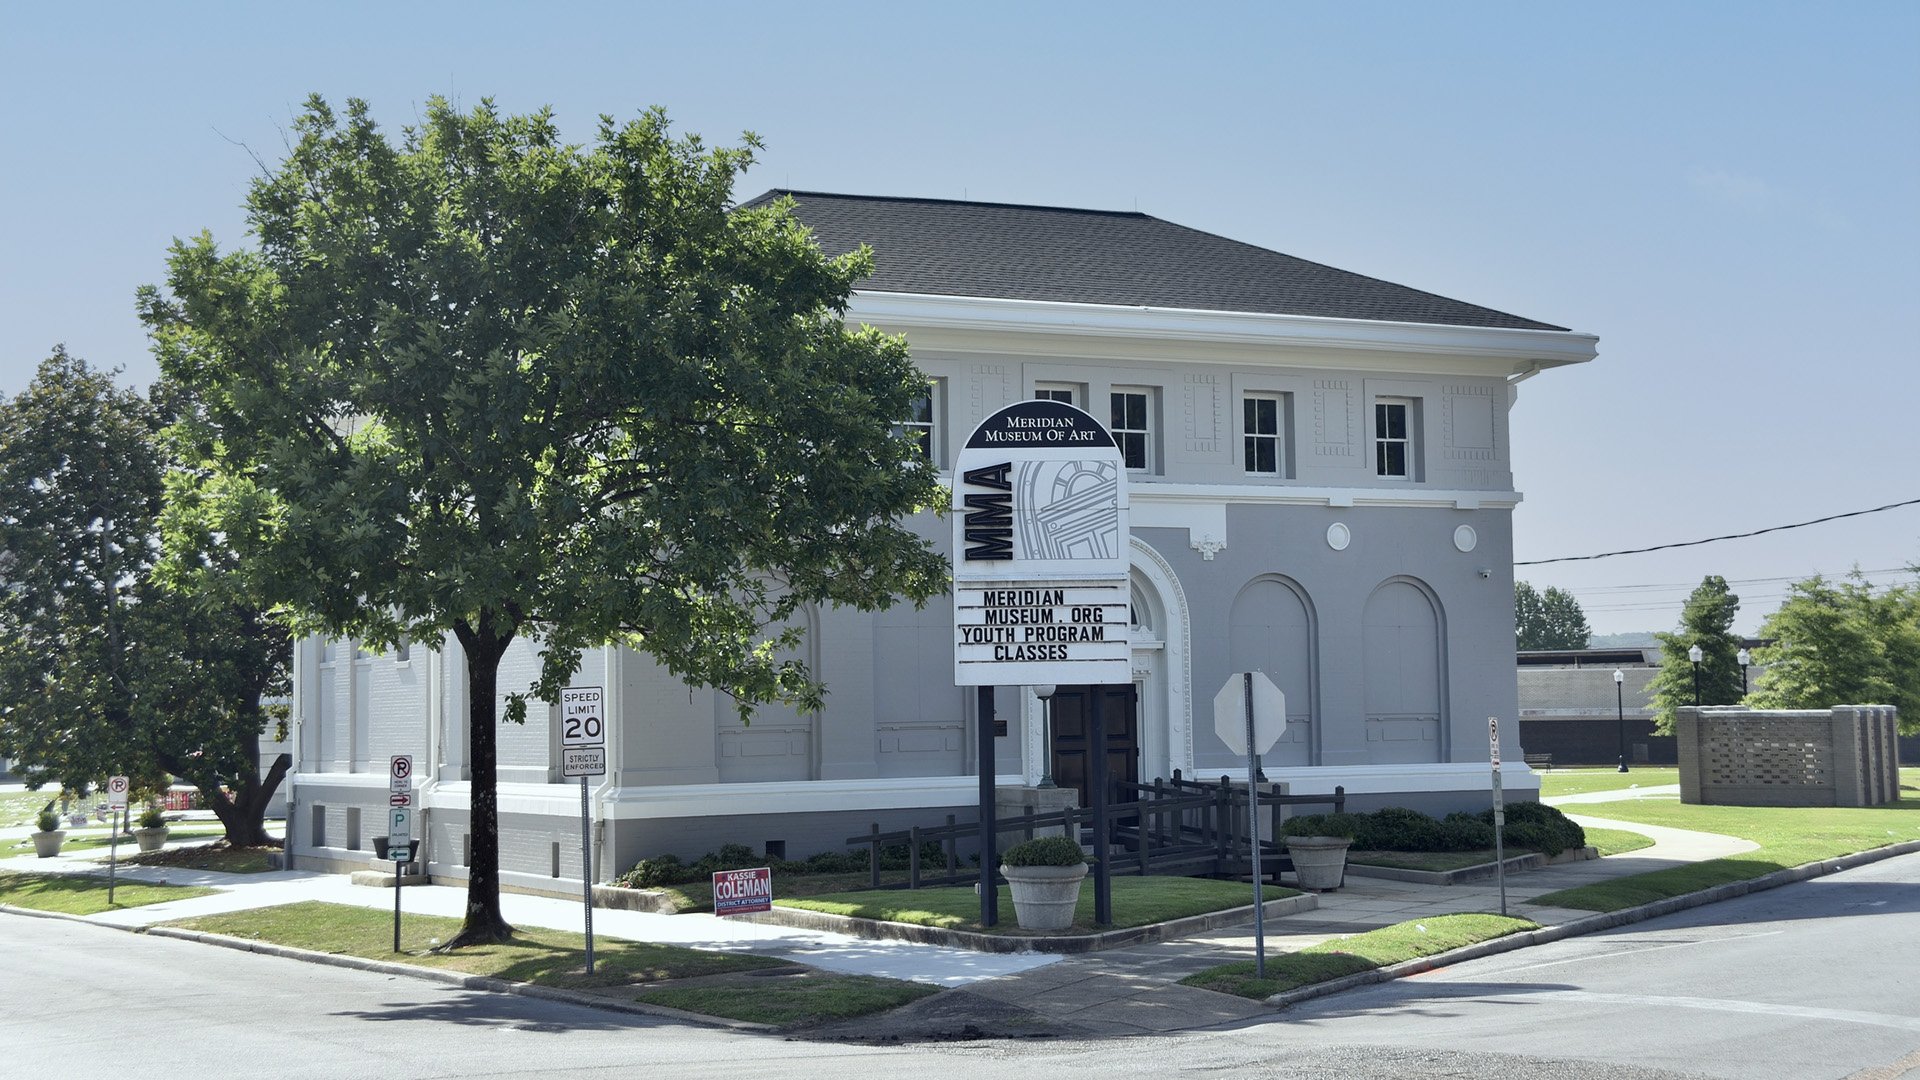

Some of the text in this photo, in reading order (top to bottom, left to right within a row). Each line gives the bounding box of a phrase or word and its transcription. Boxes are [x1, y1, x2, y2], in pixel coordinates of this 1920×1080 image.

[964, 461, 1013, 560] MMA
[984, 590, 1064, 606] MERIDIAN
[962, 626, 1104, 643] YOUTH PROGRAM
[994, 644, 1068, 661] CLASSES
[564, 692, 600, 702] SPEED
[568, 705, 596, 715] LIMIT
[565, 717, 601, 738] 20
[569, 755, 599, 763] STRICTLY
[395, 814, 404, 827] P
[727, 872, 756, 881] KASSIE
[716, 878, 769, 899] COLEMAN
